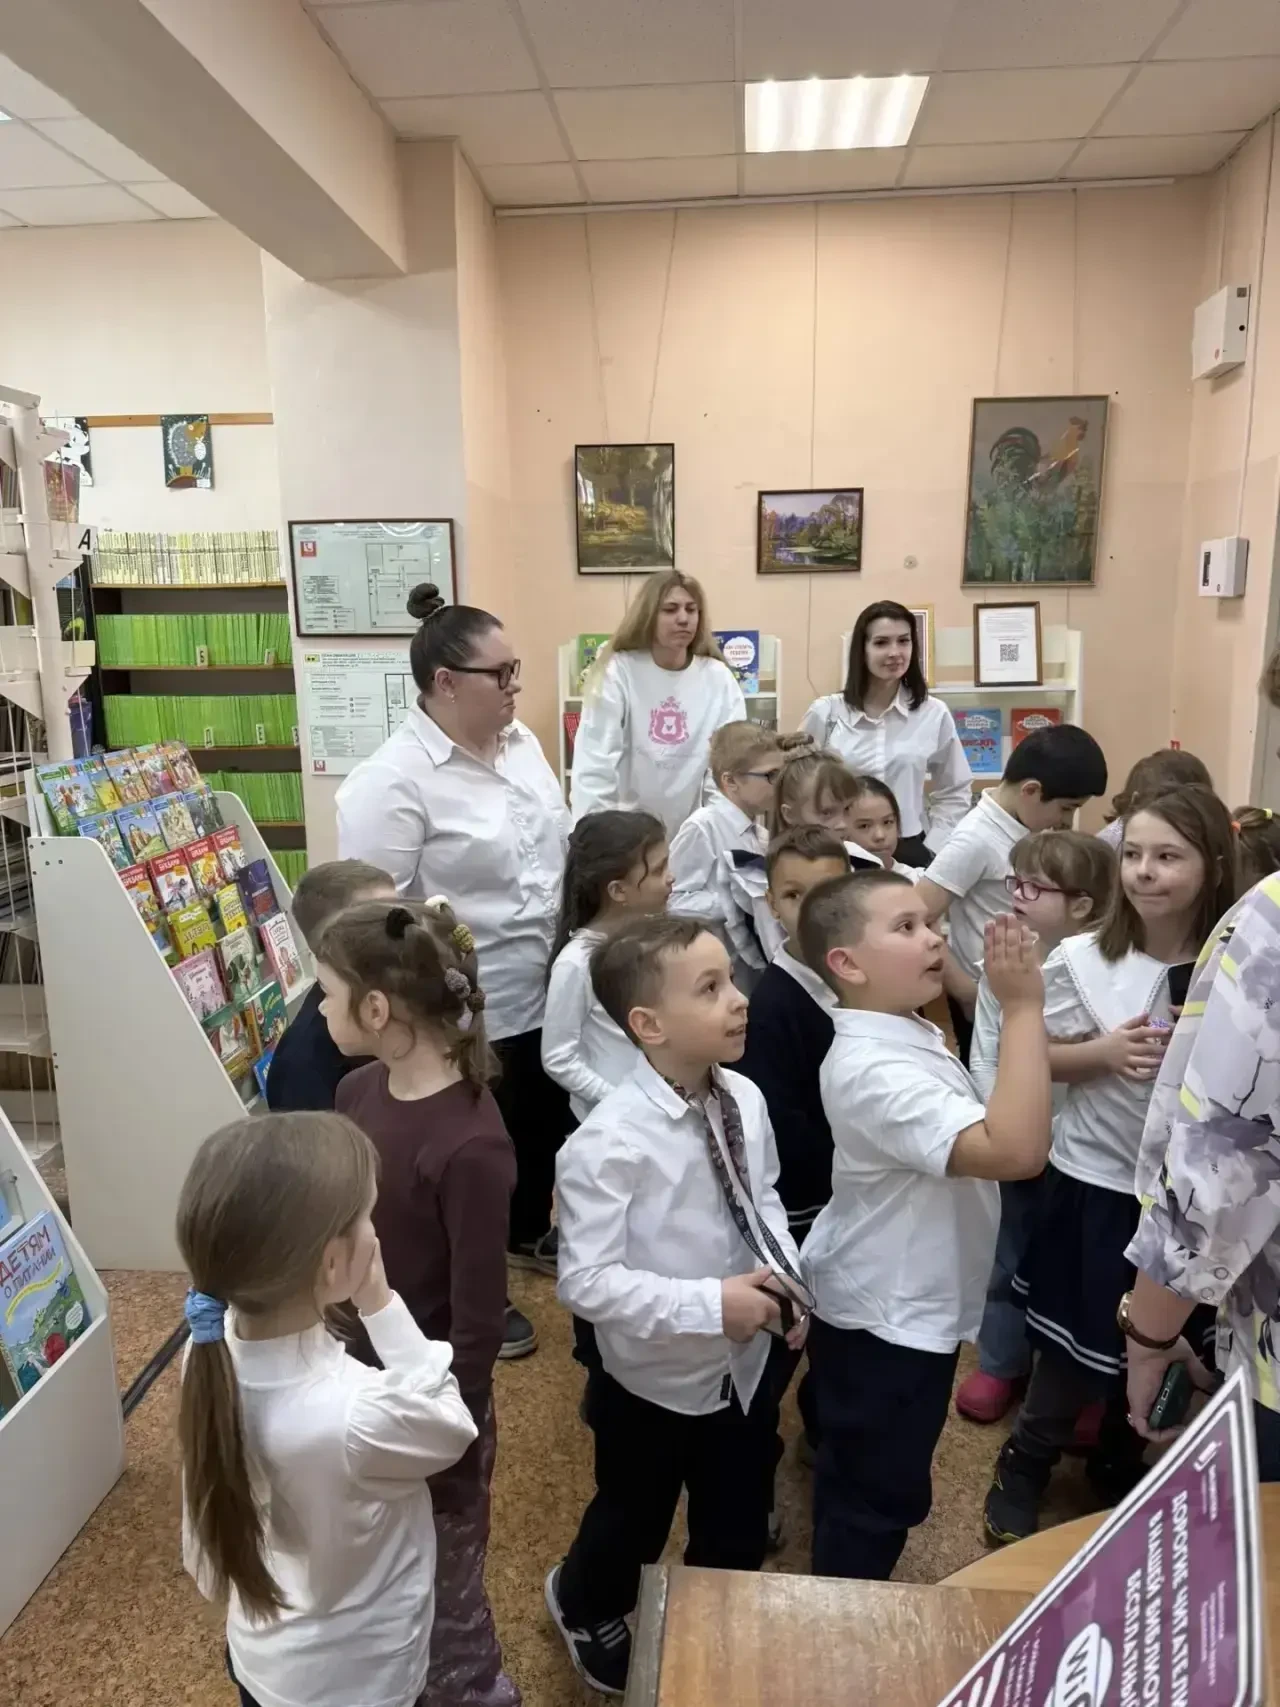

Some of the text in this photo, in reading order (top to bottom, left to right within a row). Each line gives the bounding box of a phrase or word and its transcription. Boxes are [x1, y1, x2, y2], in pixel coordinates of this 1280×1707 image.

[0, 1224, 51, 1287] ДЕТЯМ
[4, 1246, 56, 1299] О ПИТАНИИ
[1149, 1508, 1163, 1525] В
[1171, 1489, 1189, 1589] ДОРОГИЕ
[1146, 1522, 1165, 1600] НАШЕЙ
